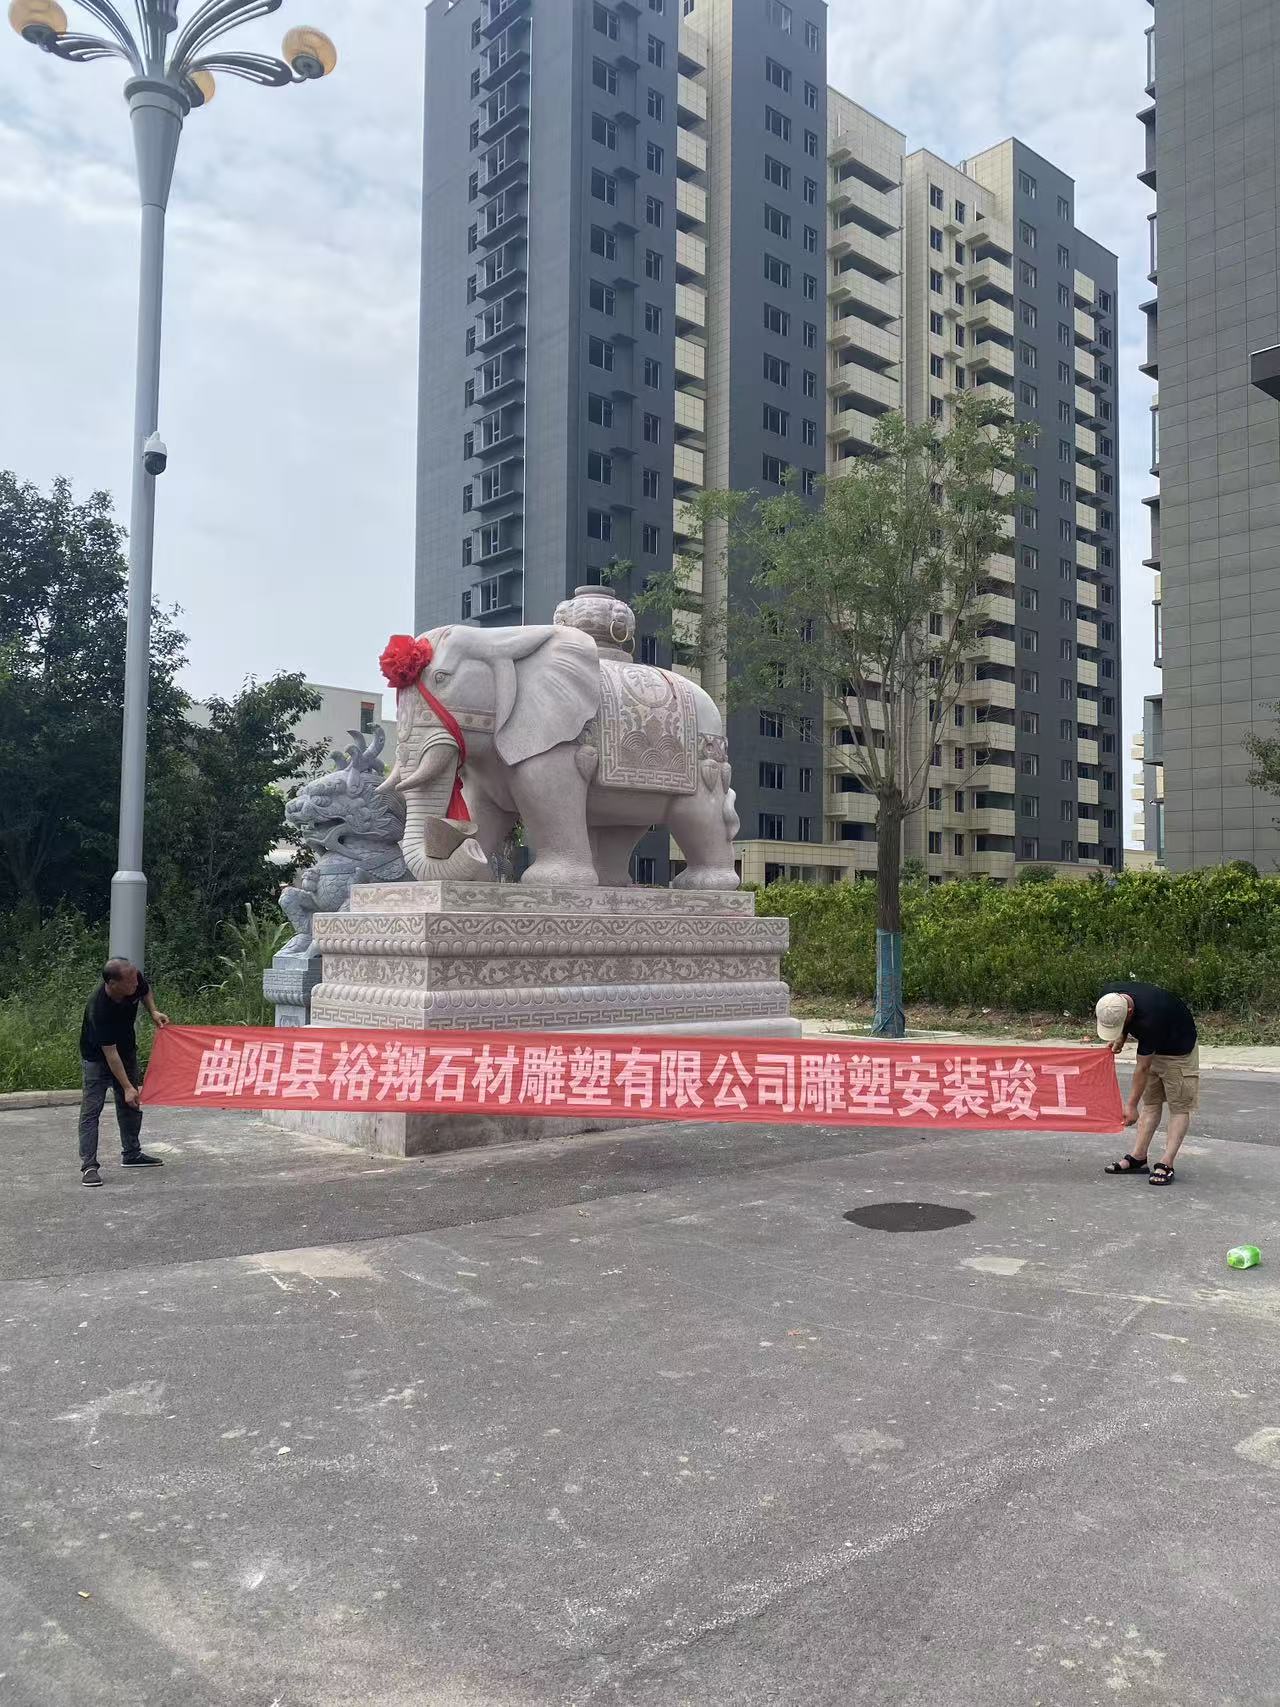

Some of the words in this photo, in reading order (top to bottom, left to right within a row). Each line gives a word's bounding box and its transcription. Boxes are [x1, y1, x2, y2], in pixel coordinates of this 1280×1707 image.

[194, 1039, 1086, 1120] 曲阳县裕翔石材雕塑有限公司雕塑安装竣工
